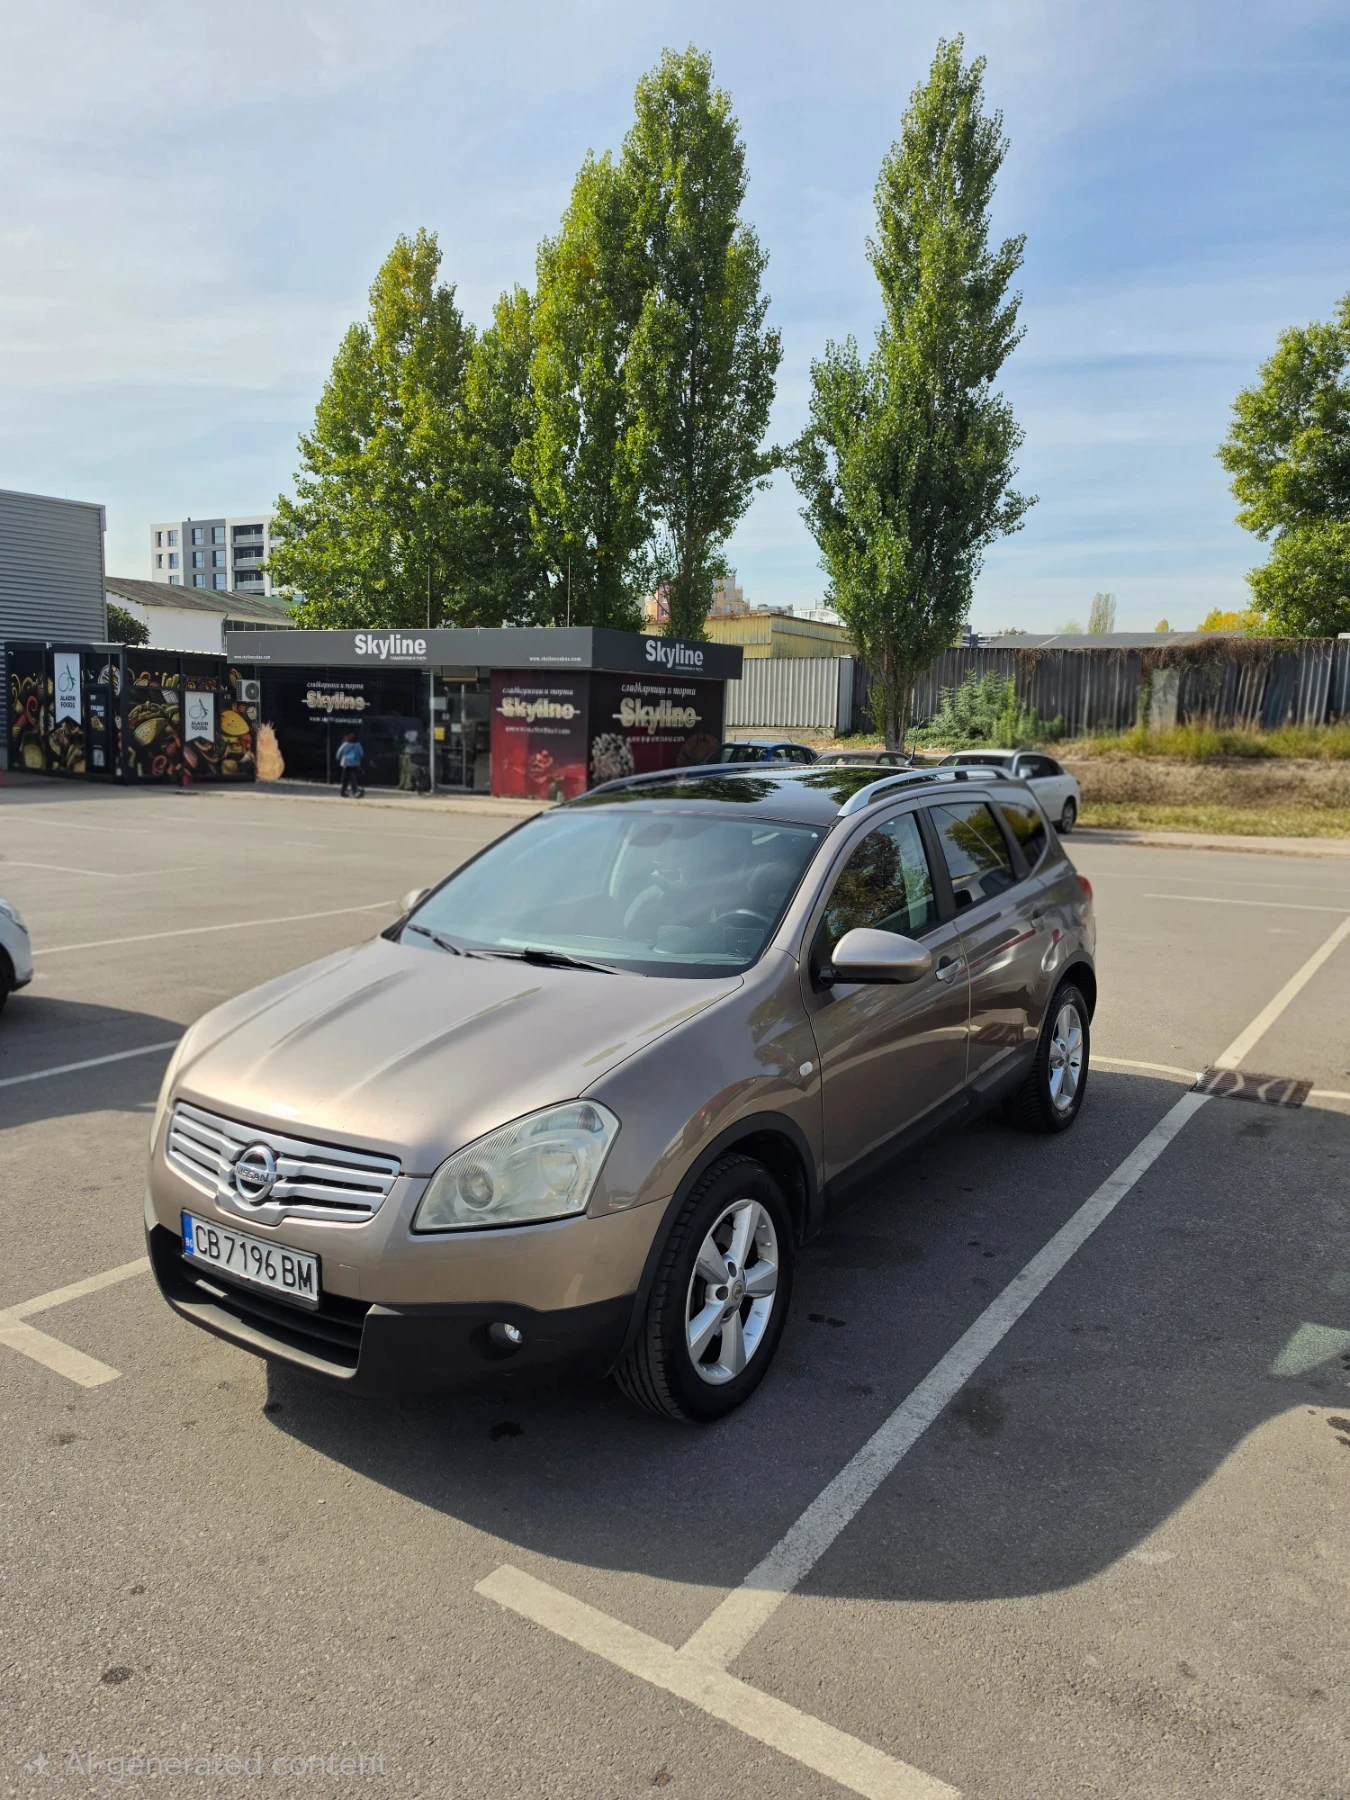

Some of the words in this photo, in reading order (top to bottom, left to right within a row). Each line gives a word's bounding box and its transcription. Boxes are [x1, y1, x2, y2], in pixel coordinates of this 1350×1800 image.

[354, 633, 427, 660] Skyline
[645, 639, 704, 669] Skyline
[306, 690, 365, 713] Skyline
[502, 697, 575, 723] Skyline
[620, 697, 697, 735] Skyline
[236, 1165, 270, 1182] NISSAN
[185, 1237, 194, 1248] BG
